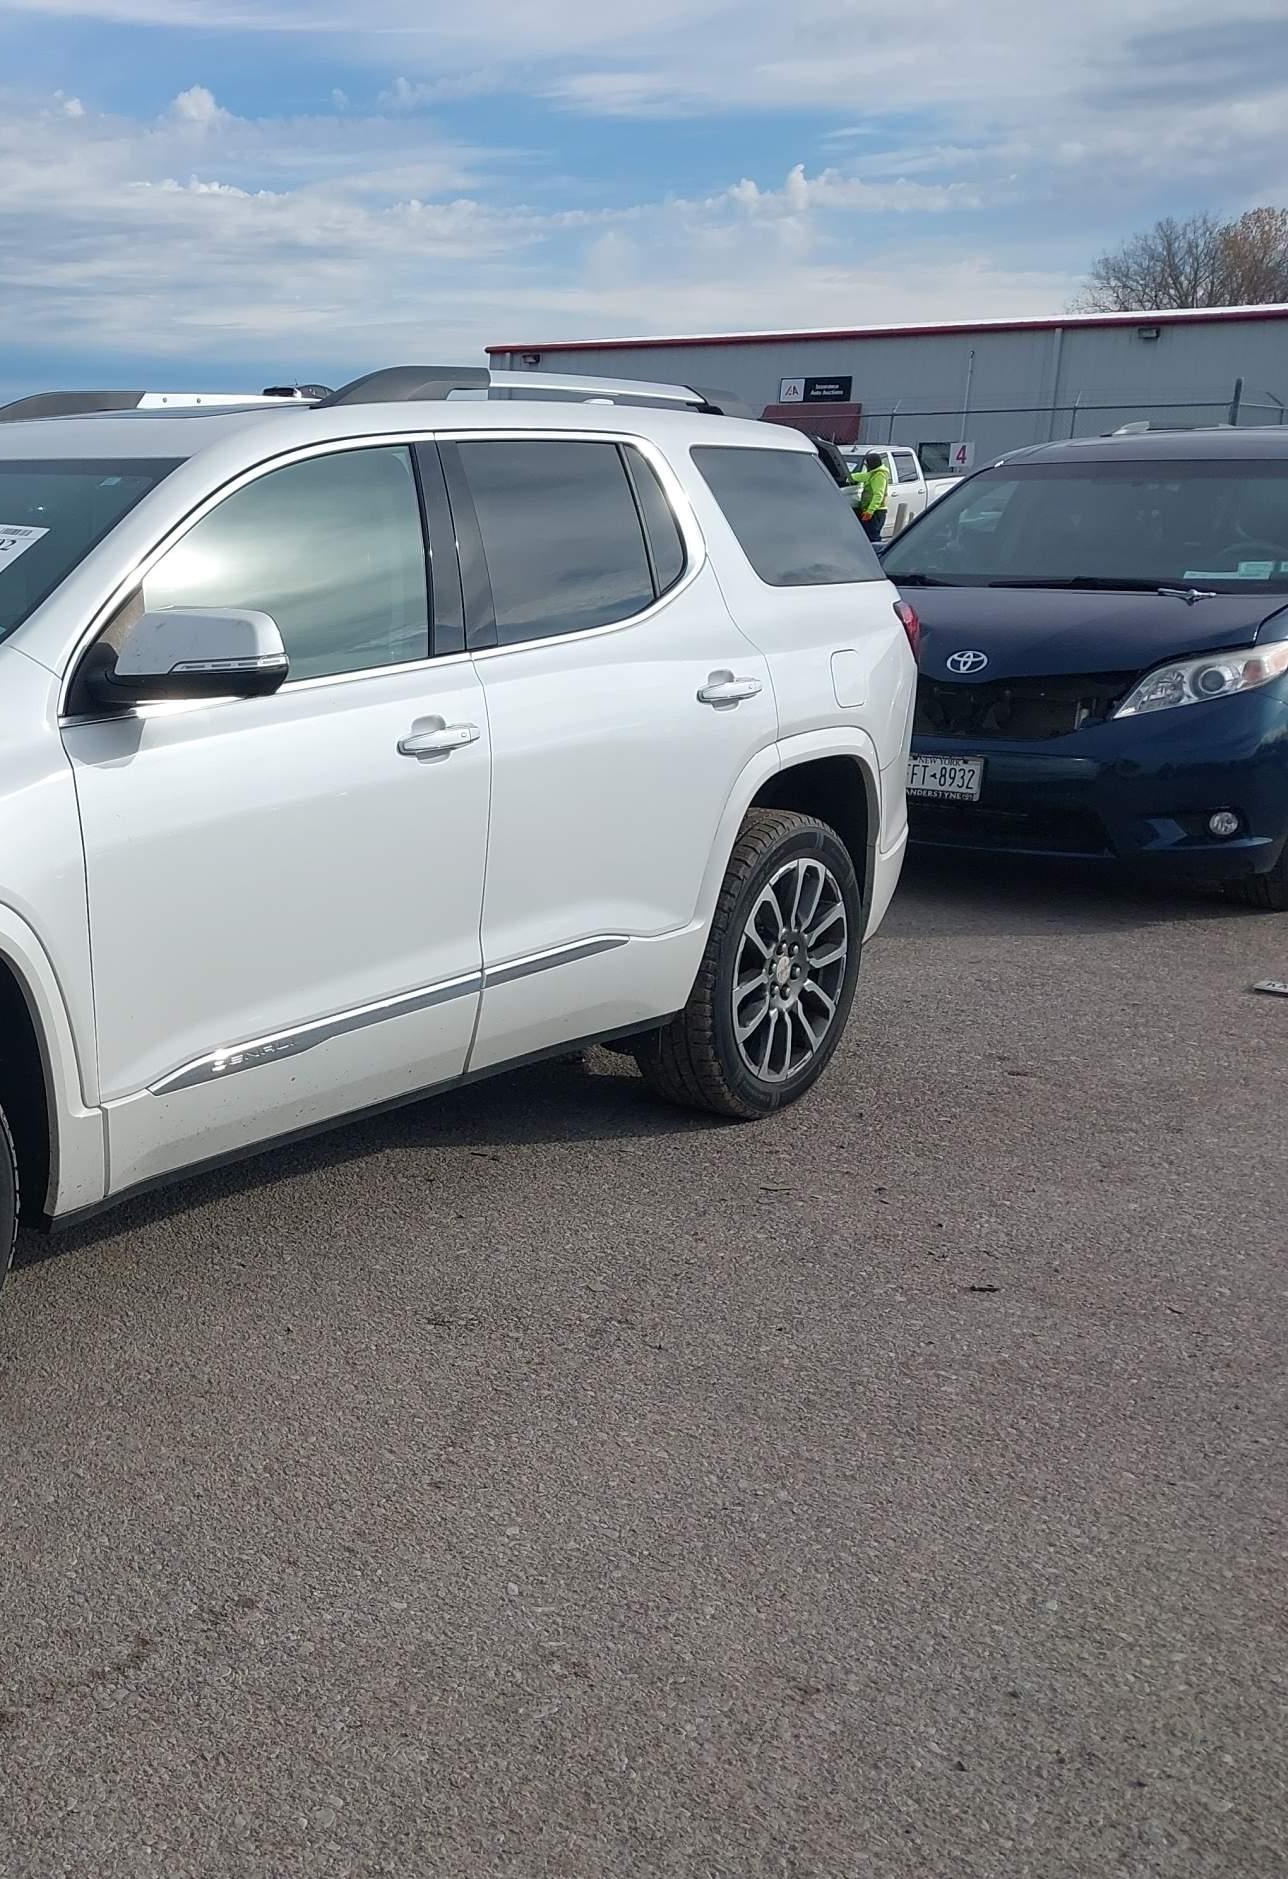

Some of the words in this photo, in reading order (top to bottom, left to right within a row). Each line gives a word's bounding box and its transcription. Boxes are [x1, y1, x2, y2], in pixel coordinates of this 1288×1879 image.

[956, 444, 967, 464] 4
[941, 758, 960, 766] YORK
[908, 764, 929, 785] FT
